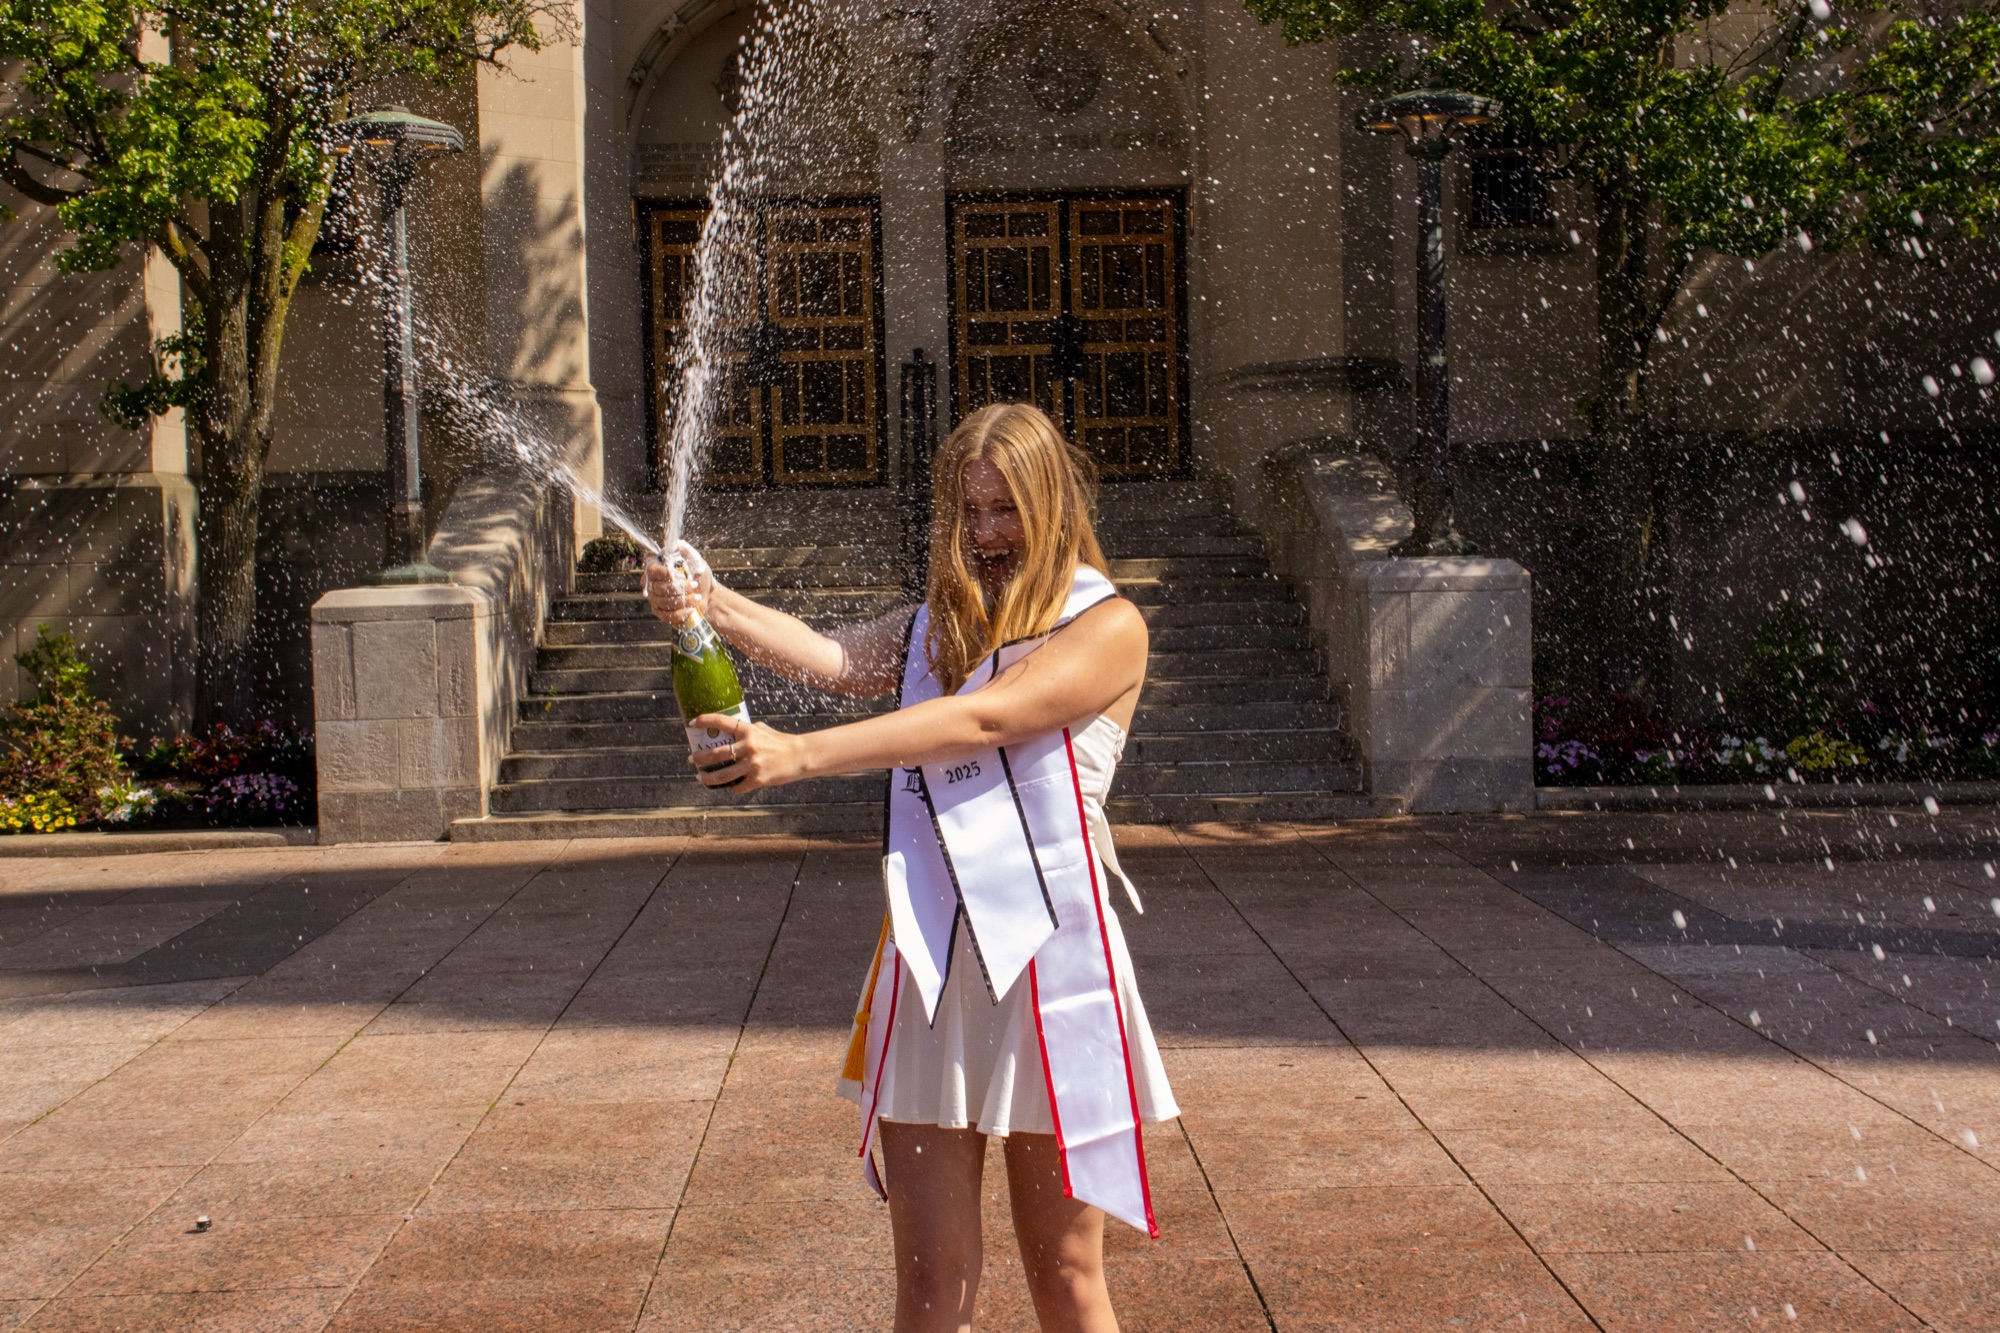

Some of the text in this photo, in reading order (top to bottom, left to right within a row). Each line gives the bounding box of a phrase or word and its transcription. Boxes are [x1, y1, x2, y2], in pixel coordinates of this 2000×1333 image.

[652, 143, 679, 152] ORDER
[682, 143, 693, 152] OF
[945, 761, 981, 784] 2025
